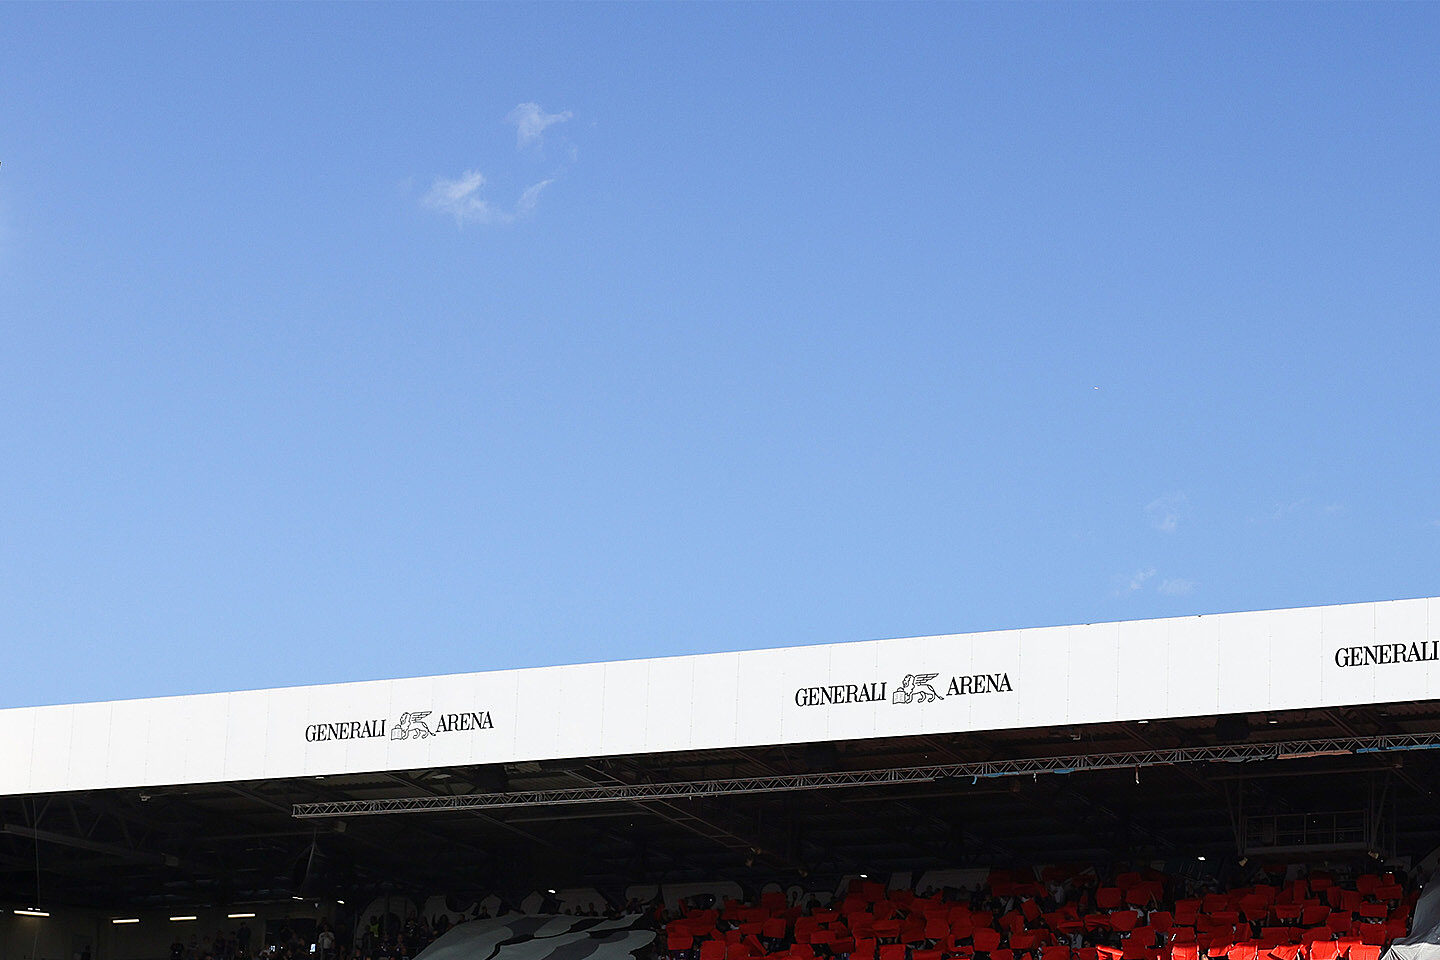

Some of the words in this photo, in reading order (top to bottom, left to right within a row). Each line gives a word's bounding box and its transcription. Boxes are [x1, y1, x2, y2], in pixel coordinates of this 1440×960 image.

[1335, 641, 1439, 667] GENERALI
[795, 682, 887, 707] GENERALI
[946, 673, 1013, 696] ARENA
[305, 719, 386, 742] GENERALI
[436, 711, 494, 732] ARENA
